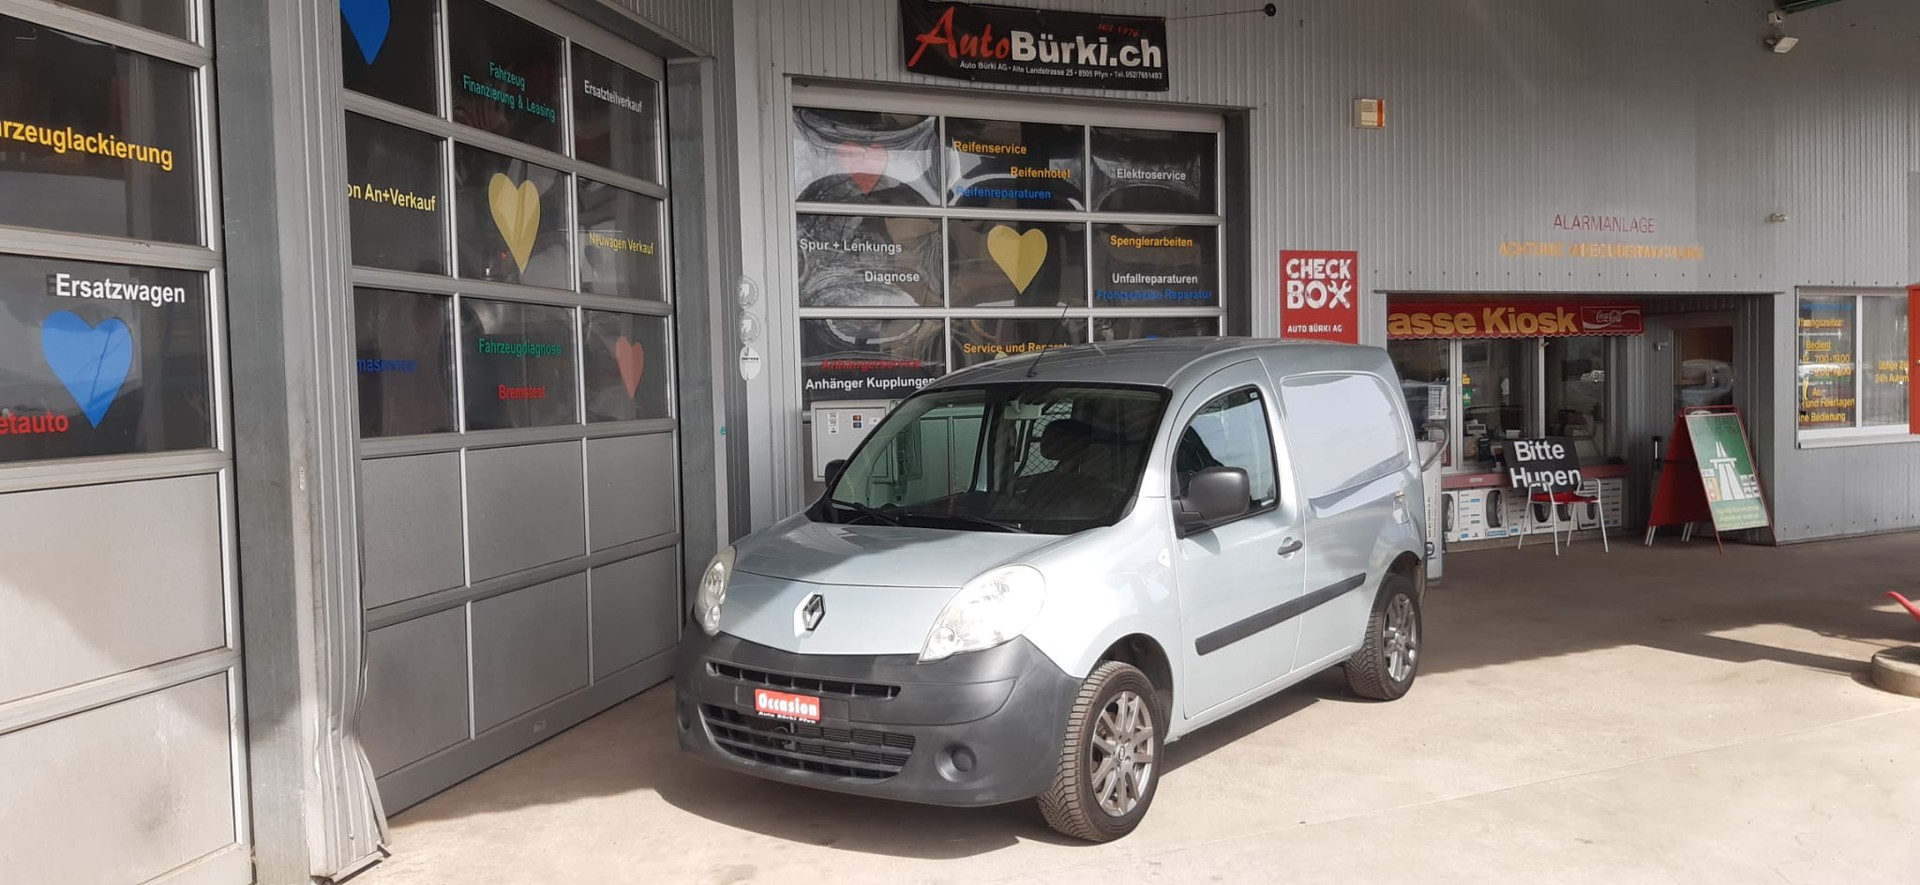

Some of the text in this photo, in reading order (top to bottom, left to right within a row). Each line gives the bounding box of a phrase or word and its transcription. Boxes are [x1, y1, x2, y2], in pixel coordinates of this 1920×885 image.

[489, 61, 526, 92] Fahrzeug
[960, 61, 976, 69] Auto
[978, 61, 997, 70] Bürki
[998, 63, 1008, 71] AG
[1012, 65, 1025, 73] Alte
[1026, 66, 1065, 76] Landstrasse
[1066, 69, 1074, 77] 25
[463, 74, 556, 123] Finanzierung & Leasing
[584, 79, 643, 113] Ersatzteilverkauf
[953, 140, 1028, 155] Reifenservice
[1010, 166, 1071, 179] Reifenhotel
[1116, 167, 1186, 181] Elektroservice
[364, 182, 436, 212] An+Verkauf
[955, 185, 1051, 200] Reifenreparaturen
[1553, 213, 1656, 234] ALARMANLAGE
[588, 230, 655, 256] Neuwagen Verkauf
[799, 238, 902, 255] Spur + Lenkungs
[1110, 234, 1194, 249] Spenglerarbeiten
[864, 271, 920, 284] Diagnose
[1285, 258, 1352, 279] CHECK
[1112, 273, 1199, 286] Unfallreparaturen
[56, 273, 186, 307] Ersatzwagen
[1287, 323, 1343, 333] AUTO BÜRKI AG
[1483, 307, 1579, 335] Kiosk
[479, 337, 562, 358] Fahrzeugdiagnose
[963, 342, 1003, 353] Service
[1005, 341, 1026, 353] und
[498, 383, 546, 400] Bremstest
[805, 377, 864, 392] Anhänger
[1513, 440, 1566, 462] Bitte
[1509, 466, 1582, 492] Hupen
[758, 692, 818, 718] Occasion
